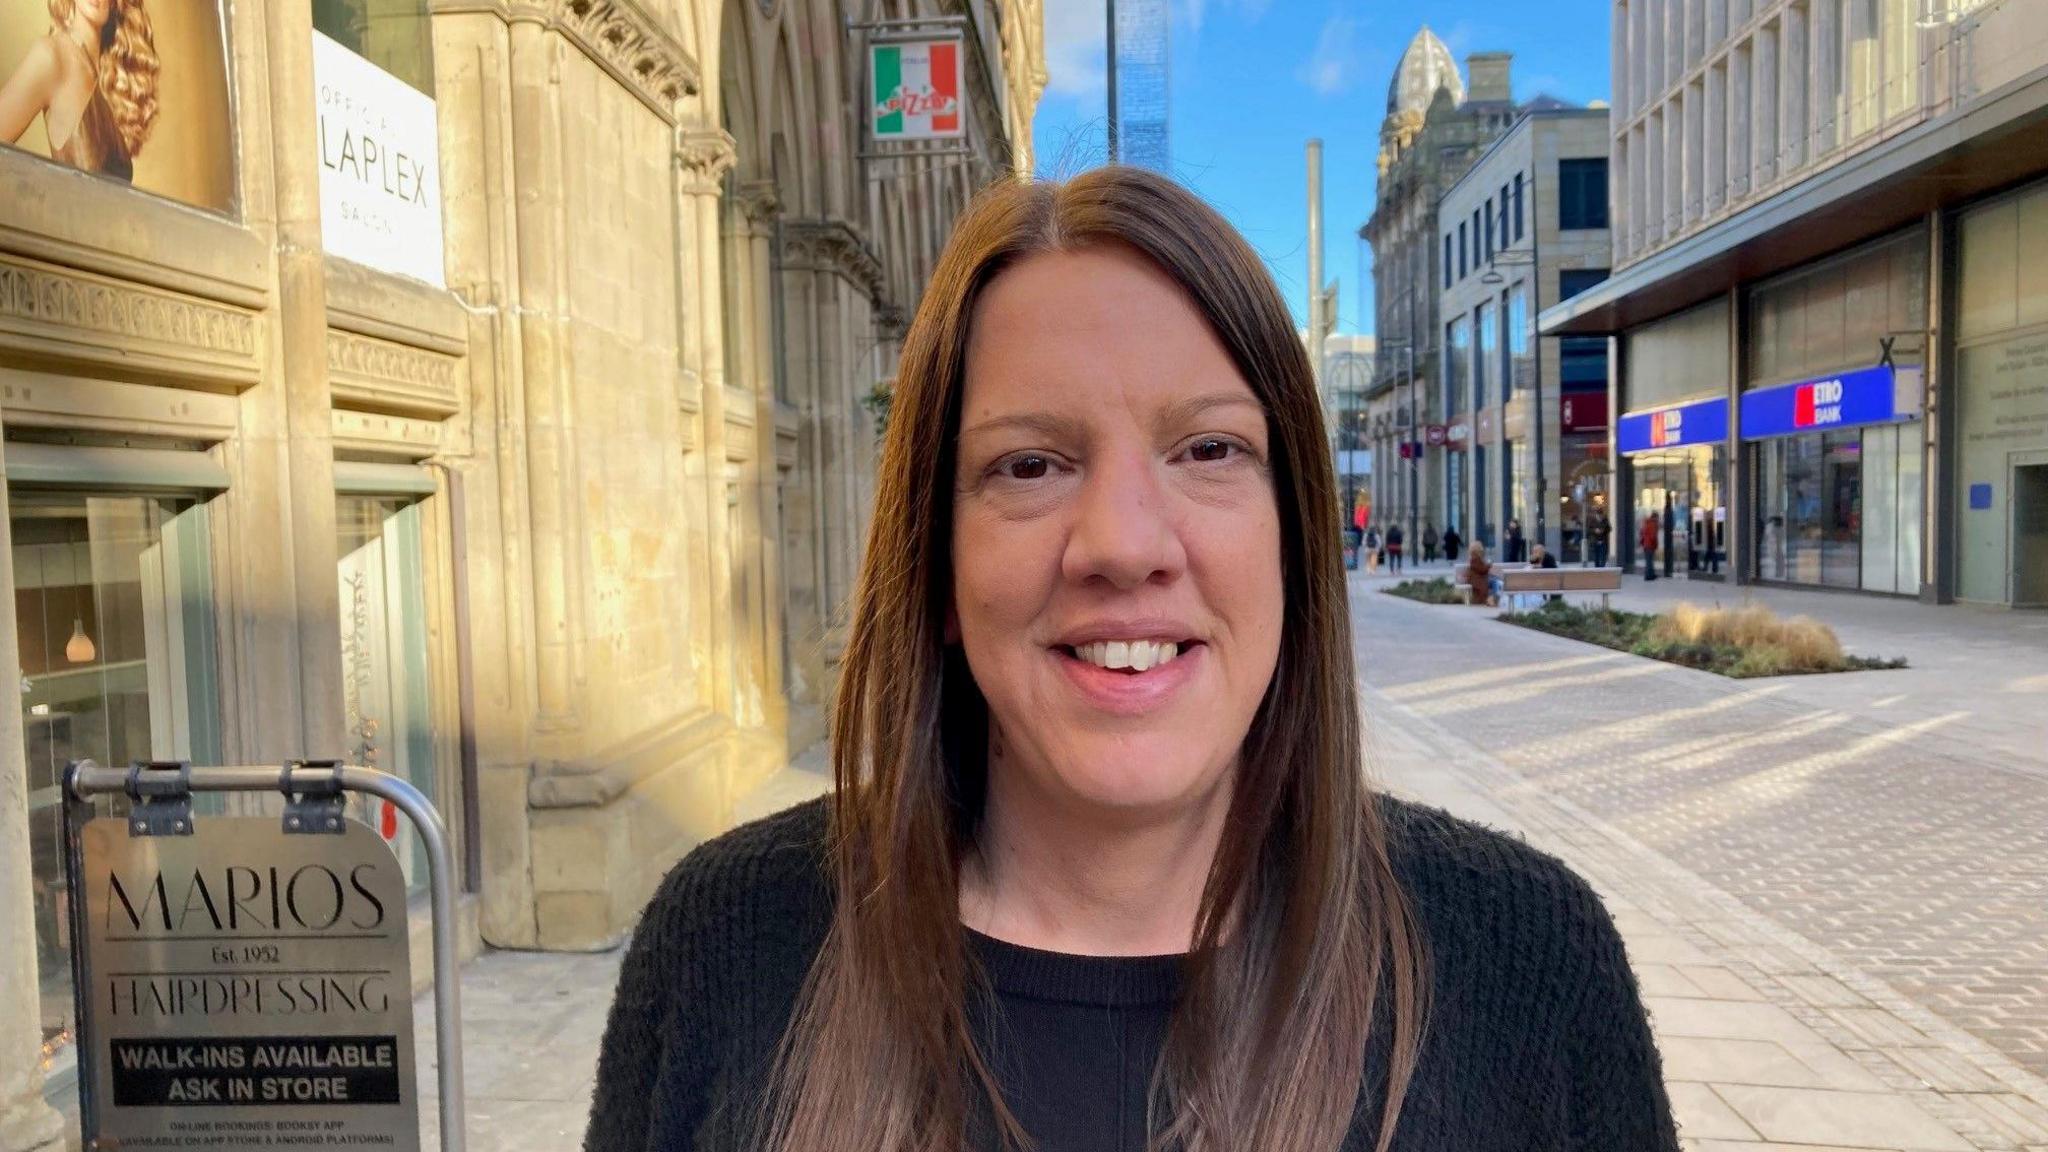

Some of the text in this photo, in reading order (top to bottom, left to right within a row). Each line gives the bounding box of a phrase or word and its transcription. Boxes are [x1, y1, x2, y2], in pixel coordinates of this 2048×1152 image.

[321, 84, 397, 137] OFFICA
[106, 863, 386, 932] MARIOS
[243, 946, 281, 963] 1952
[110, 976, 390, 1017] HAIRDRESSING
[118, 1044, 393, 1069] WALK-INS AVAILABLE
[168, 1076, 348, 1099] ASK IN STORE
